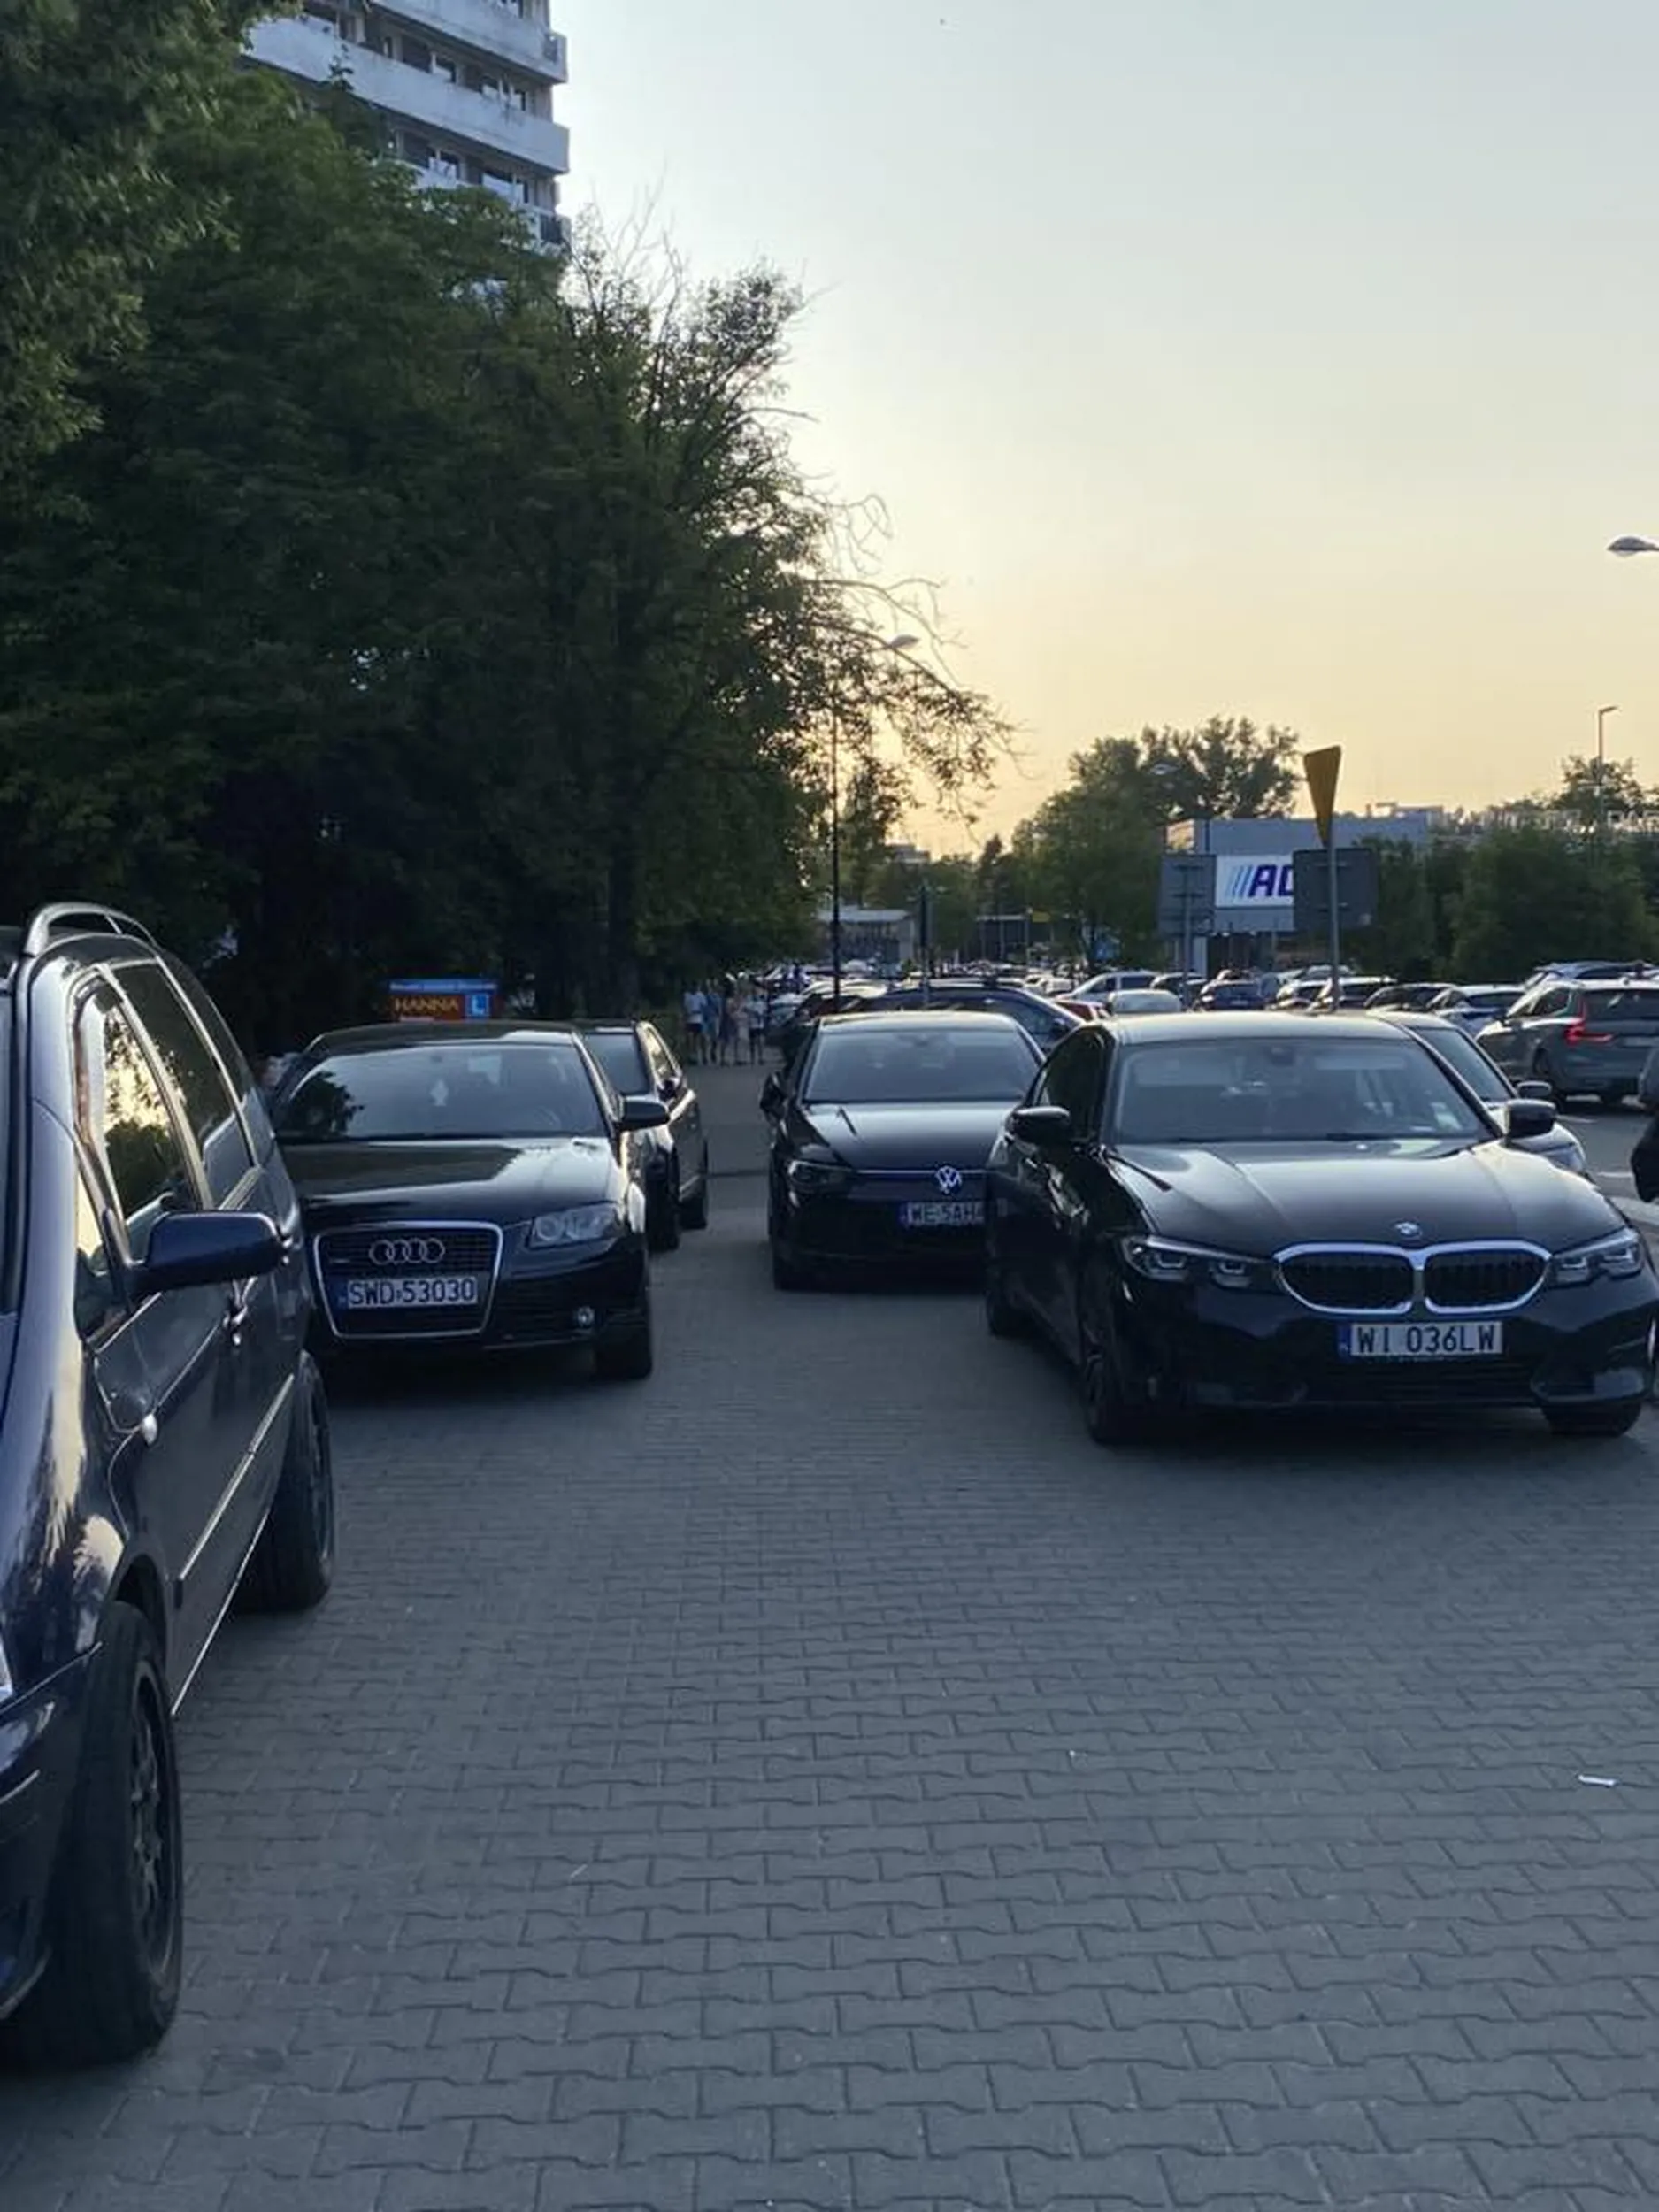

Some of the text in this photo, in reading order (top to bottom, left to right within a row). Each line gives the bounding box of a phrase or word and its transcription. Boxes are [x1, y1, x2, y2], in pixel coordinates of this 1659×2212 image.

[349, 1279, 476, 1305] SWD 53030
[1357, 1325, 1494, 1353] WI 036LW
